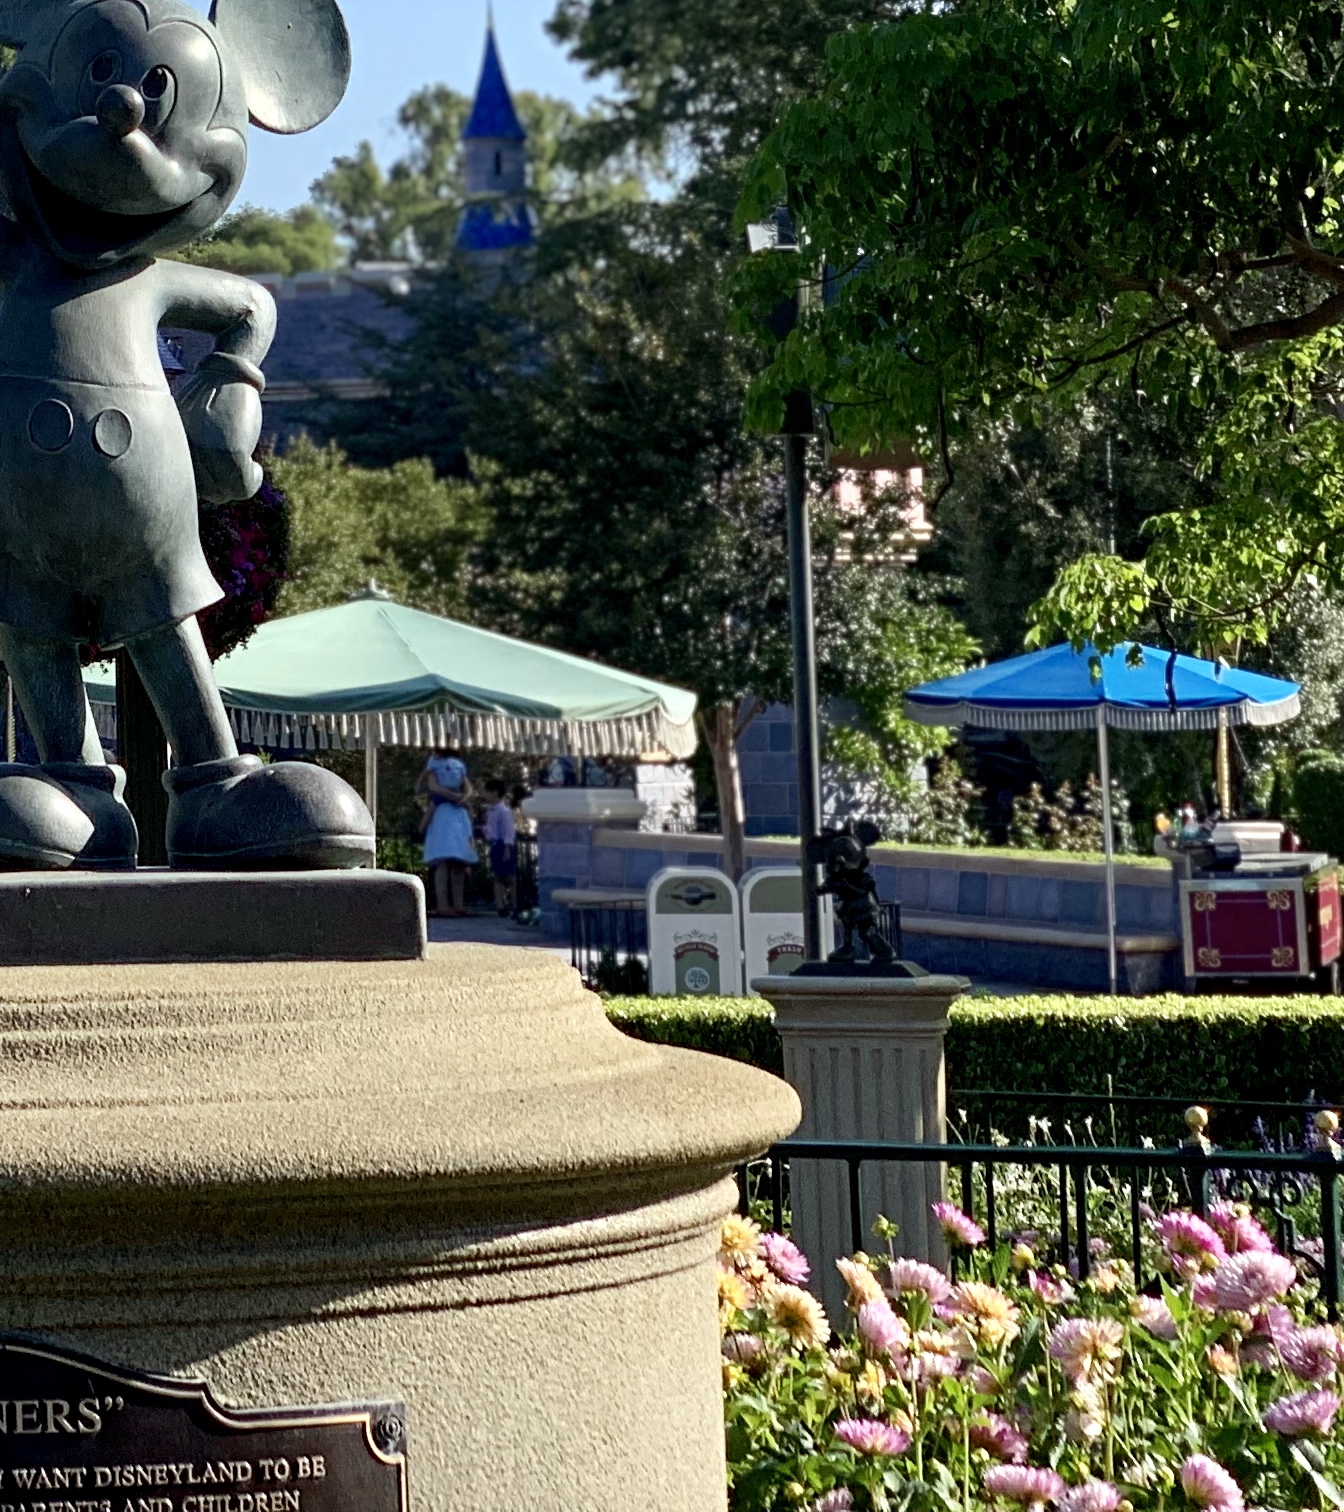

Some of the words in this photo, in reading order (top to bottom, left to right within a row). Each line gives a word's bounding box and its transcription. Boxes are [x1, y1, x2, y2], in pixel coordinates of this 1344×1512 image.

[11, 1466, 88, 1490] WANT
[93, 1459, 253, 1489] DISNEYLAND
[259, 1456, 291, 1481] TO
[296, 1454, 327, 1479] BE
[123, 1497, 173, 1512] AND
[181, 1488, 301, 1512] CHILDREN
